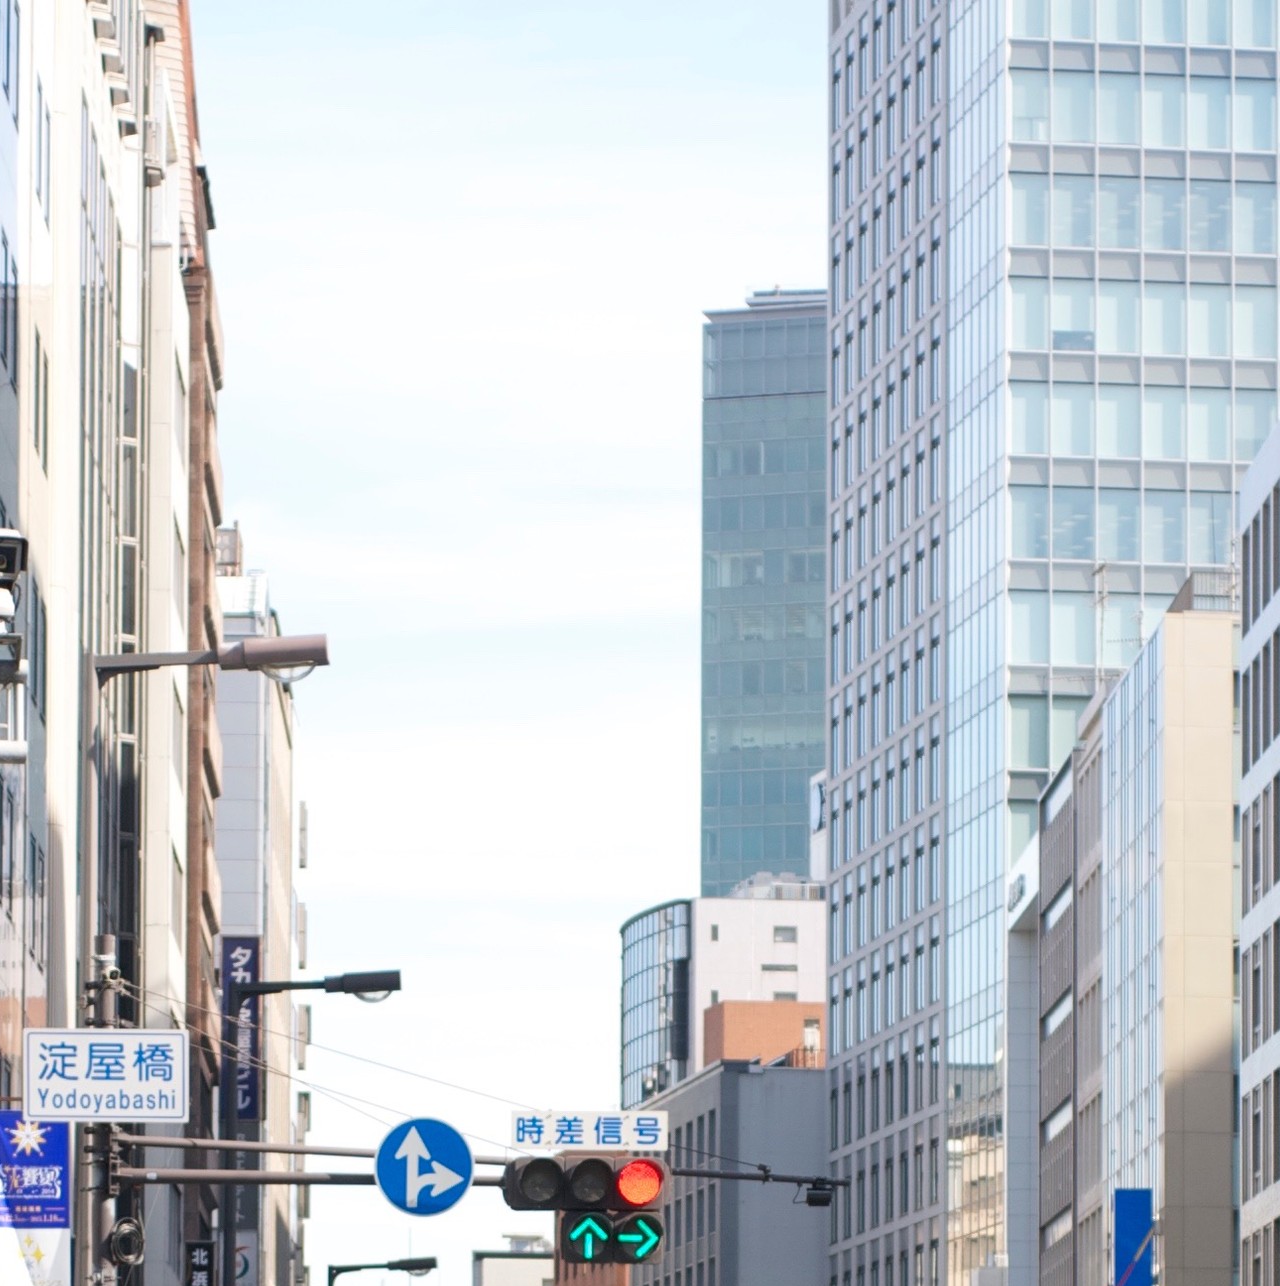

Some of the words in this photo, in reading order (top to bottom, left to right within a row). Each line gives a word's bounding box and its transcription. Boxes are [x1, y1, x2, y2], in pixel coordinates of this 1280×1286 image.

[38, 1041, 174, 1082] 淀屋橋
[37, 1088, 176, 1113] Yodoyabashi
[516, 1116, 662, 1145] 時差信号
